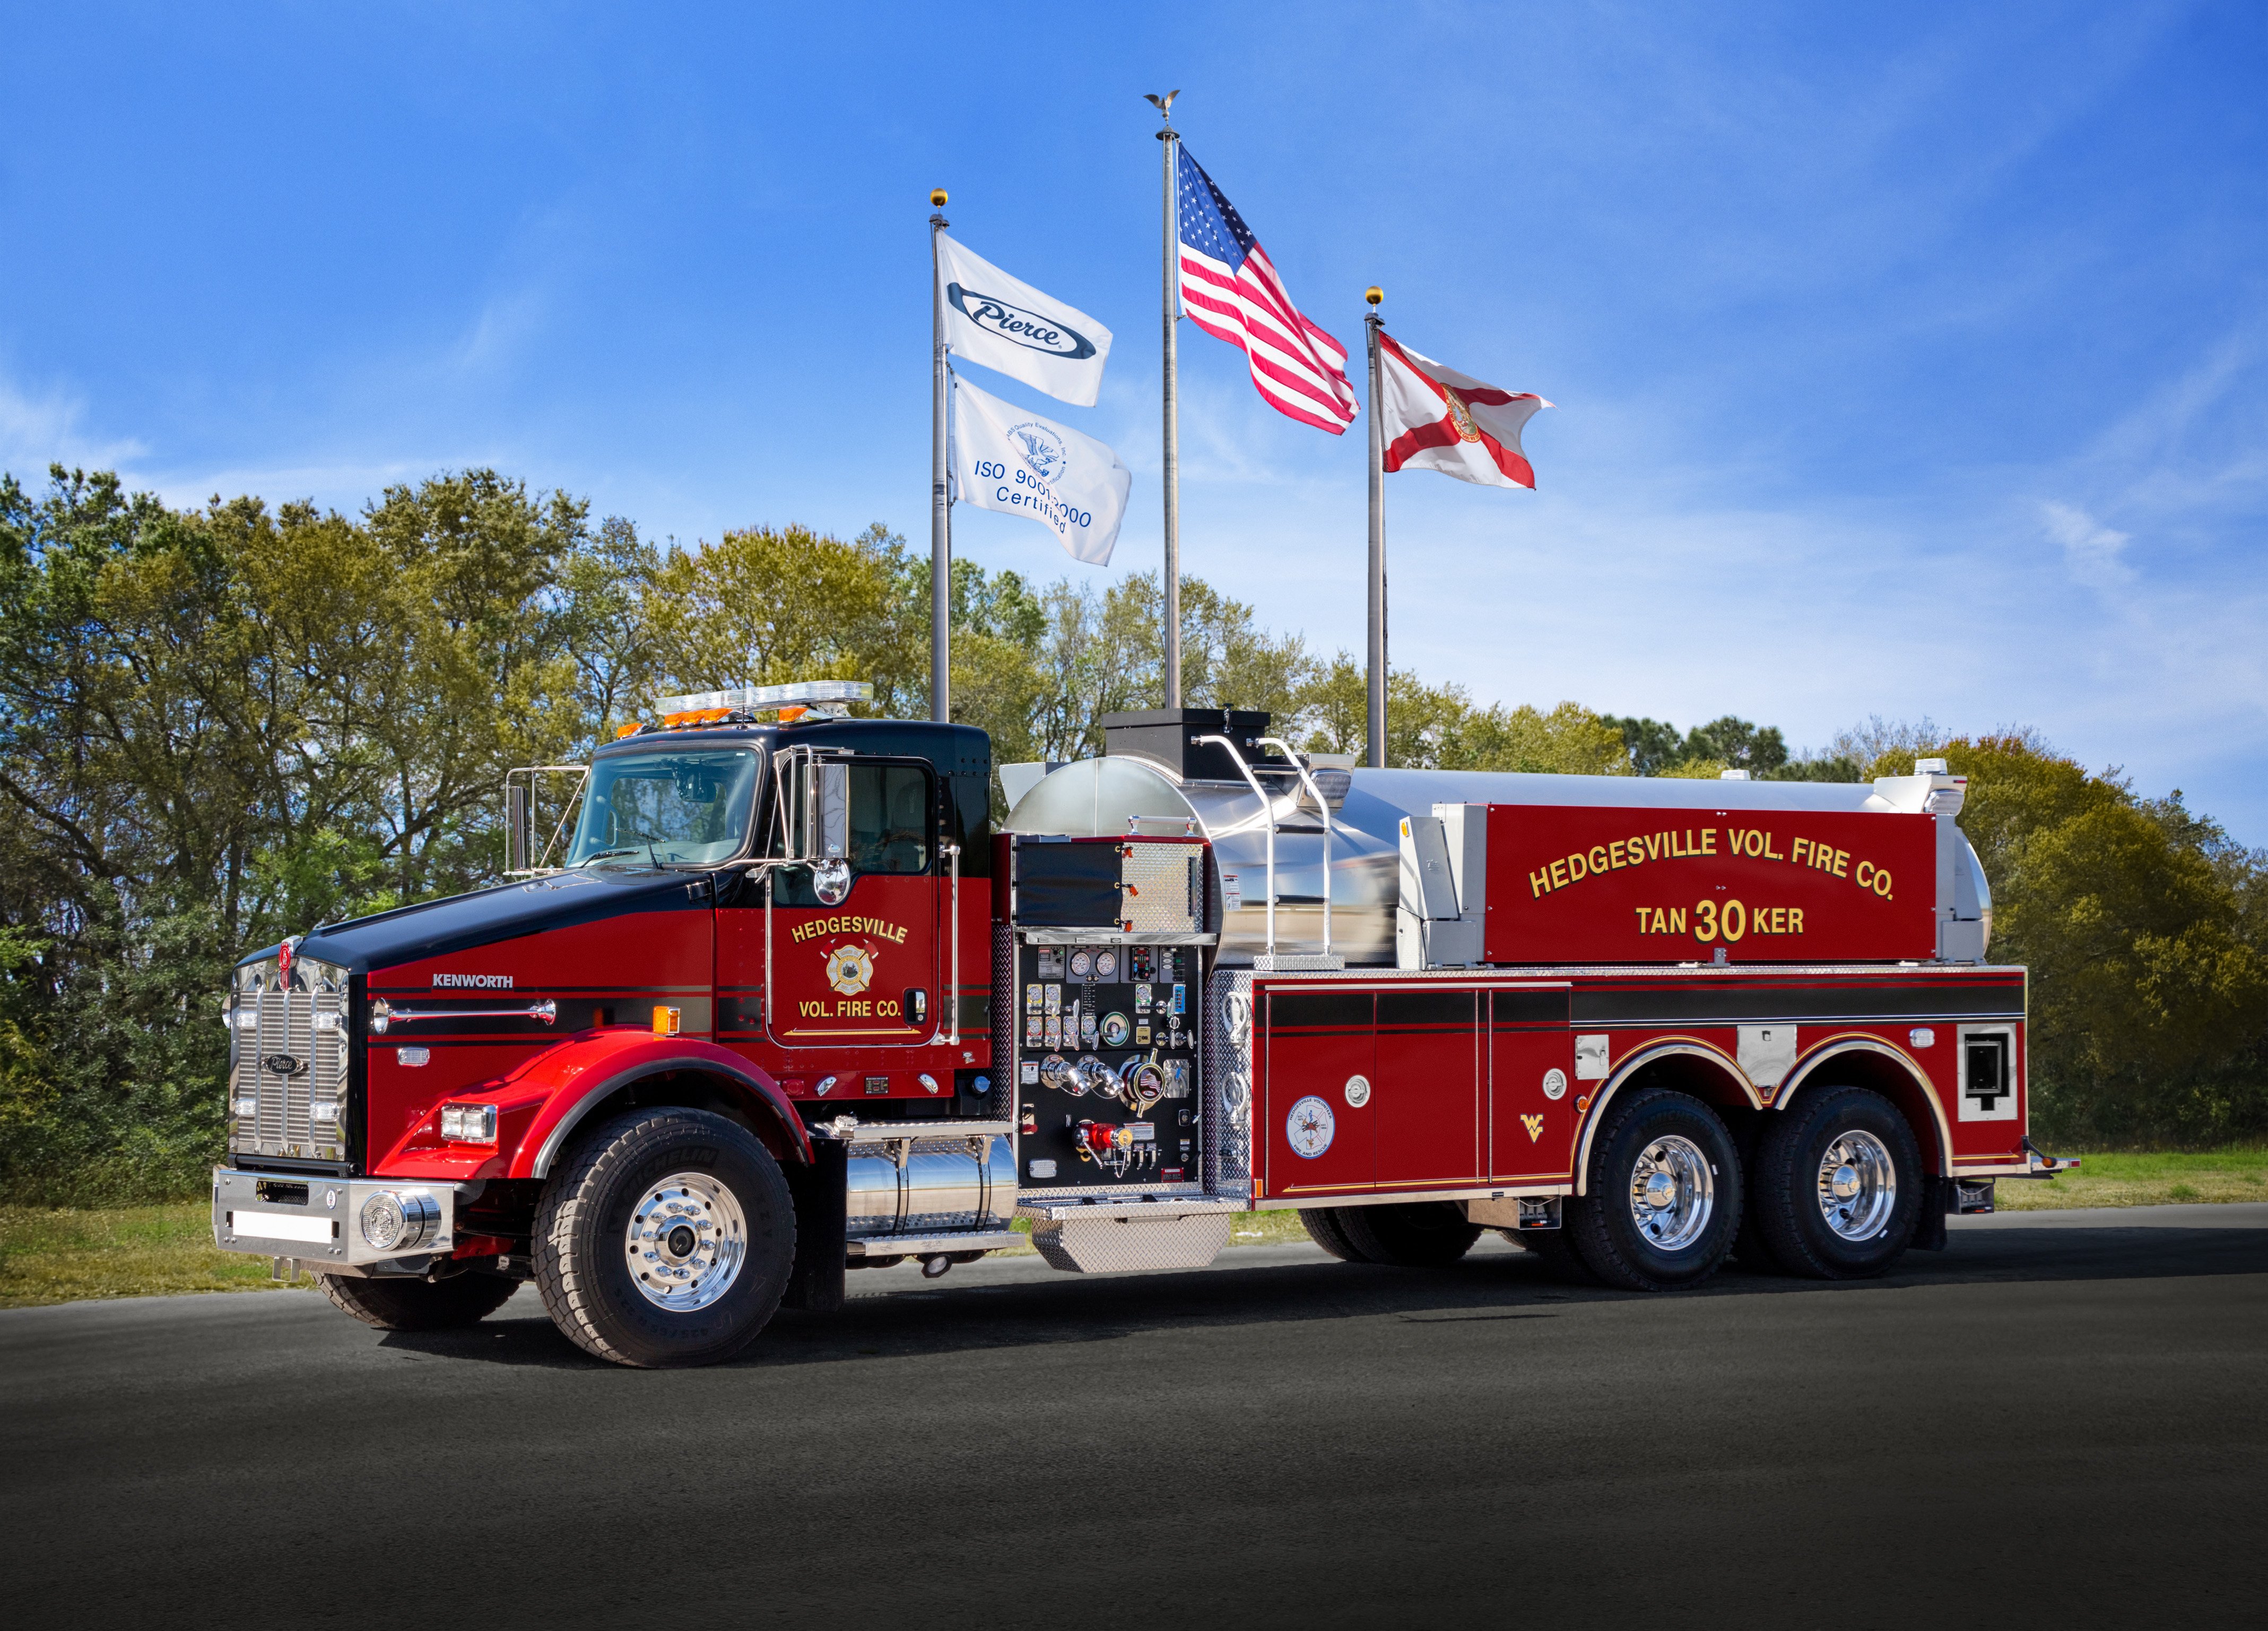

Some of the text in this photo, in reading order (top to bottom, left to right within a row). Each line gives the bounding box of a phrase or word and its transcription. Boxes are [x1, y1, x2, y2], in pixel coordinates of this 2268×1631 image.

[972, 301, 1060, 345] Pierce
[975, 460, 1005, 479] ISO
[996, 486, 1066, 534] Certified
[1530, 828, 1893, 901] HEDGESVILLE VOL. FIRE CO.
[792, 916, 908, 944] HEDGESVILLE
[1636, 900, 1803, 941] TAN 30 KER
[433, 974, 513, 988] KENWORTH
[799, 1000, 901, 1017] VOL. FIRE CO.
[270, 1056, 293, 1070] Pierce
[1289, 1098, 1332, 1120] HEDGESVILLE VOLUNTEER
[1313, 1144, 1328, 1155] RESCUE
[623, 1148, 718, 1203] MICHELIN
